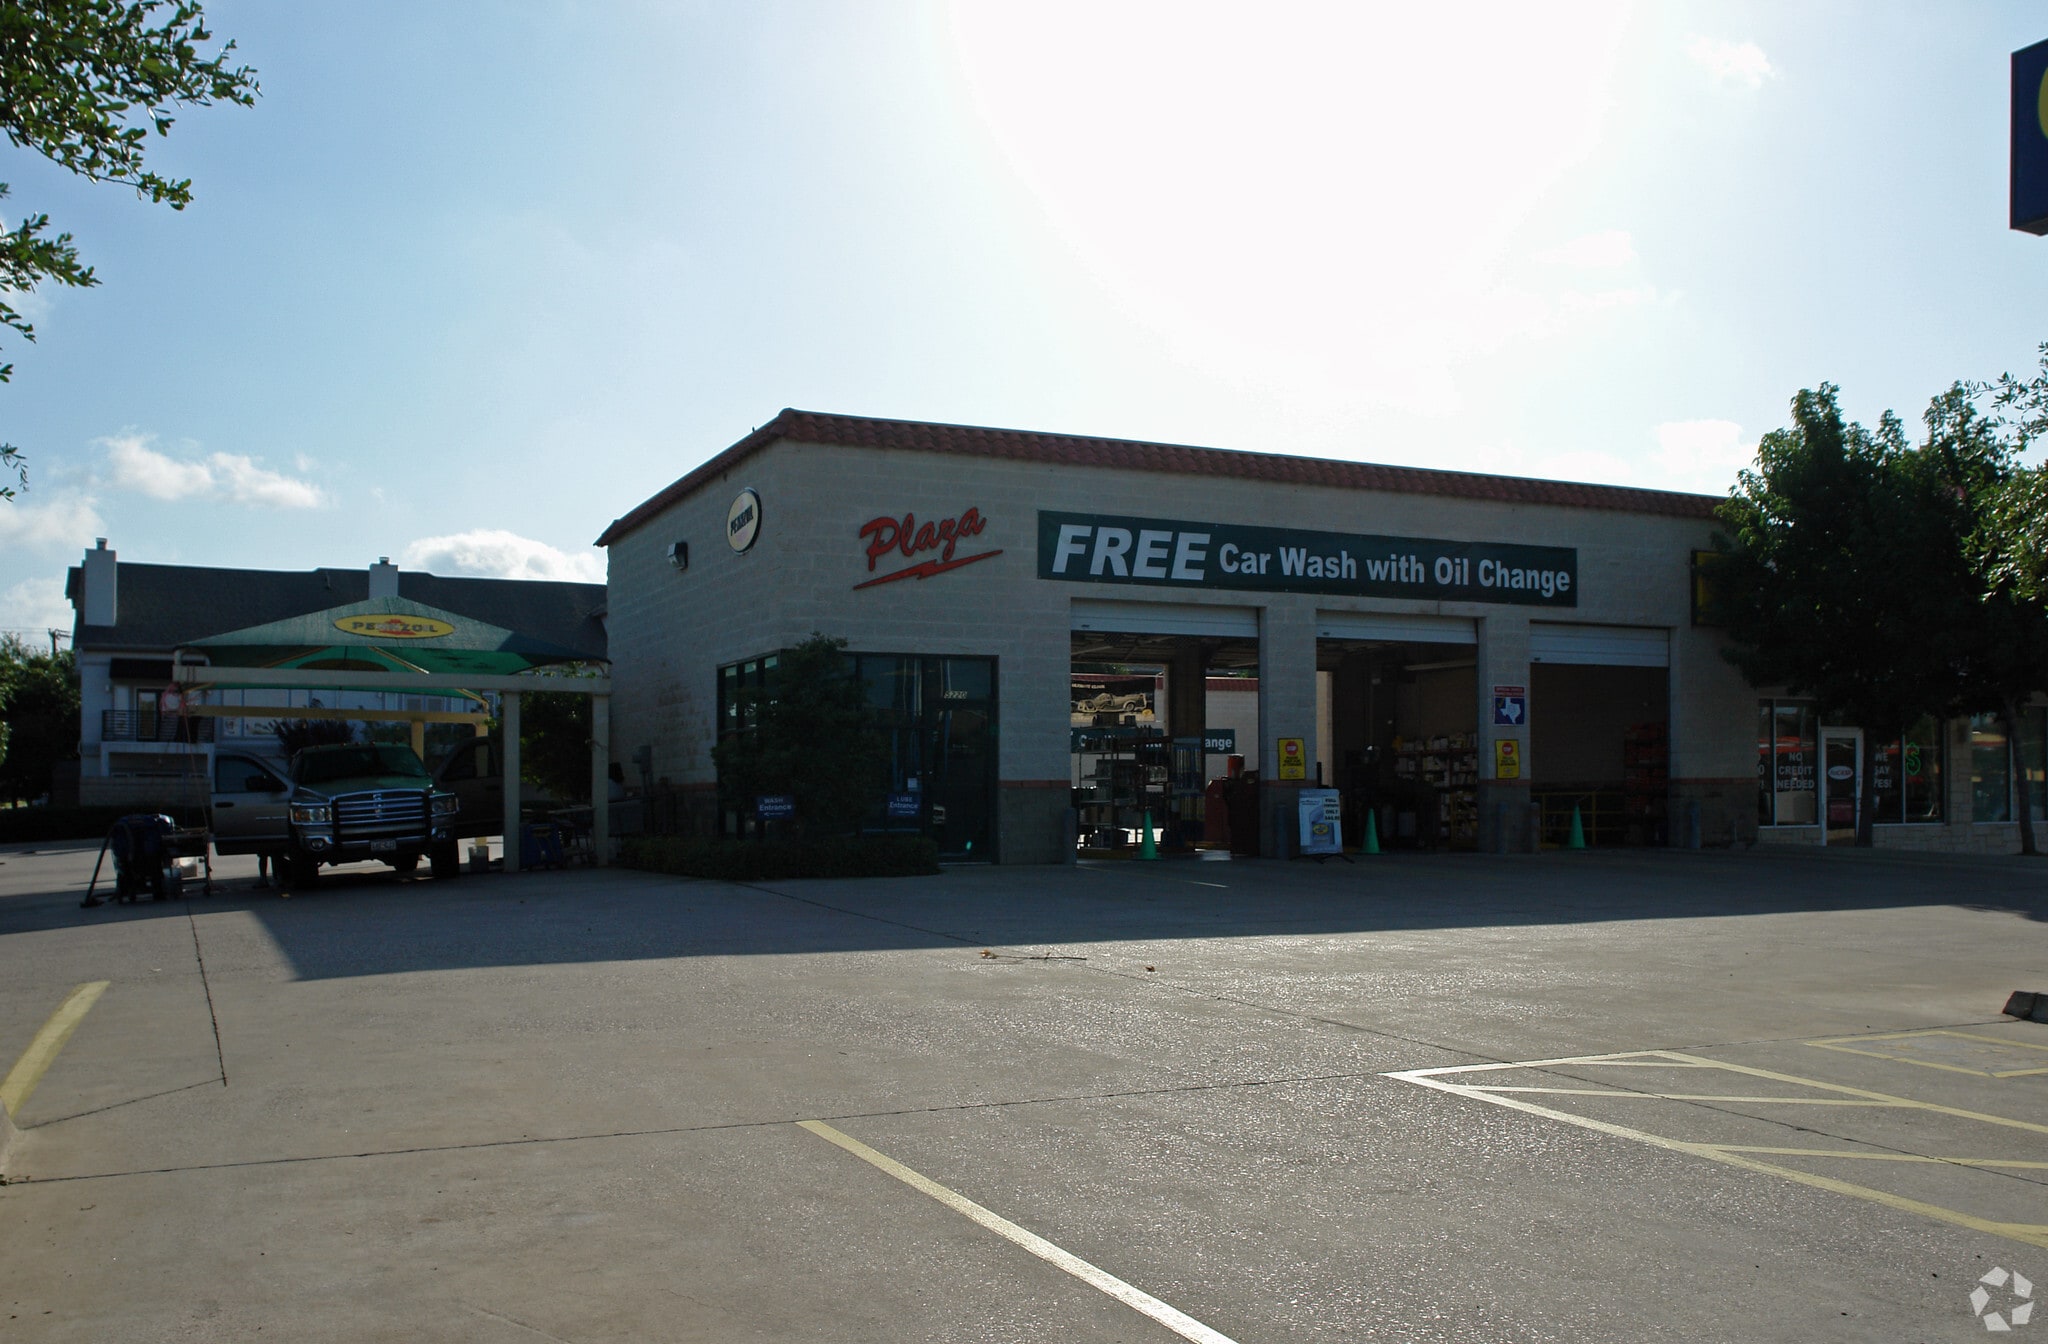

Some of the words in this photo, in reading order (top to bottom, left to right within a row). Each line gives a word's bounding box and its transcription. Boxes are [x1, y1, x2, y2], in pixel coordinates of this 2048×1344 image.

[859, 506, 987, 572] Plaza
[1051, 523, 1211, 581] FREE
[1218, 542, 1272, 575] Car
[1278, 545, 1357, 580] Wash
[1365, 553, 1425, 584] with
[1433, 556, 1470, 586] Oil
[1477, 558, 1571, 598] Change
[1788, 752, 1803, 762] NO
[1777, 765, 1814, 776] CREDIT
[1776, 780, 1816, 790] NEEDED
[759, 804, 792, 812] Entrance
